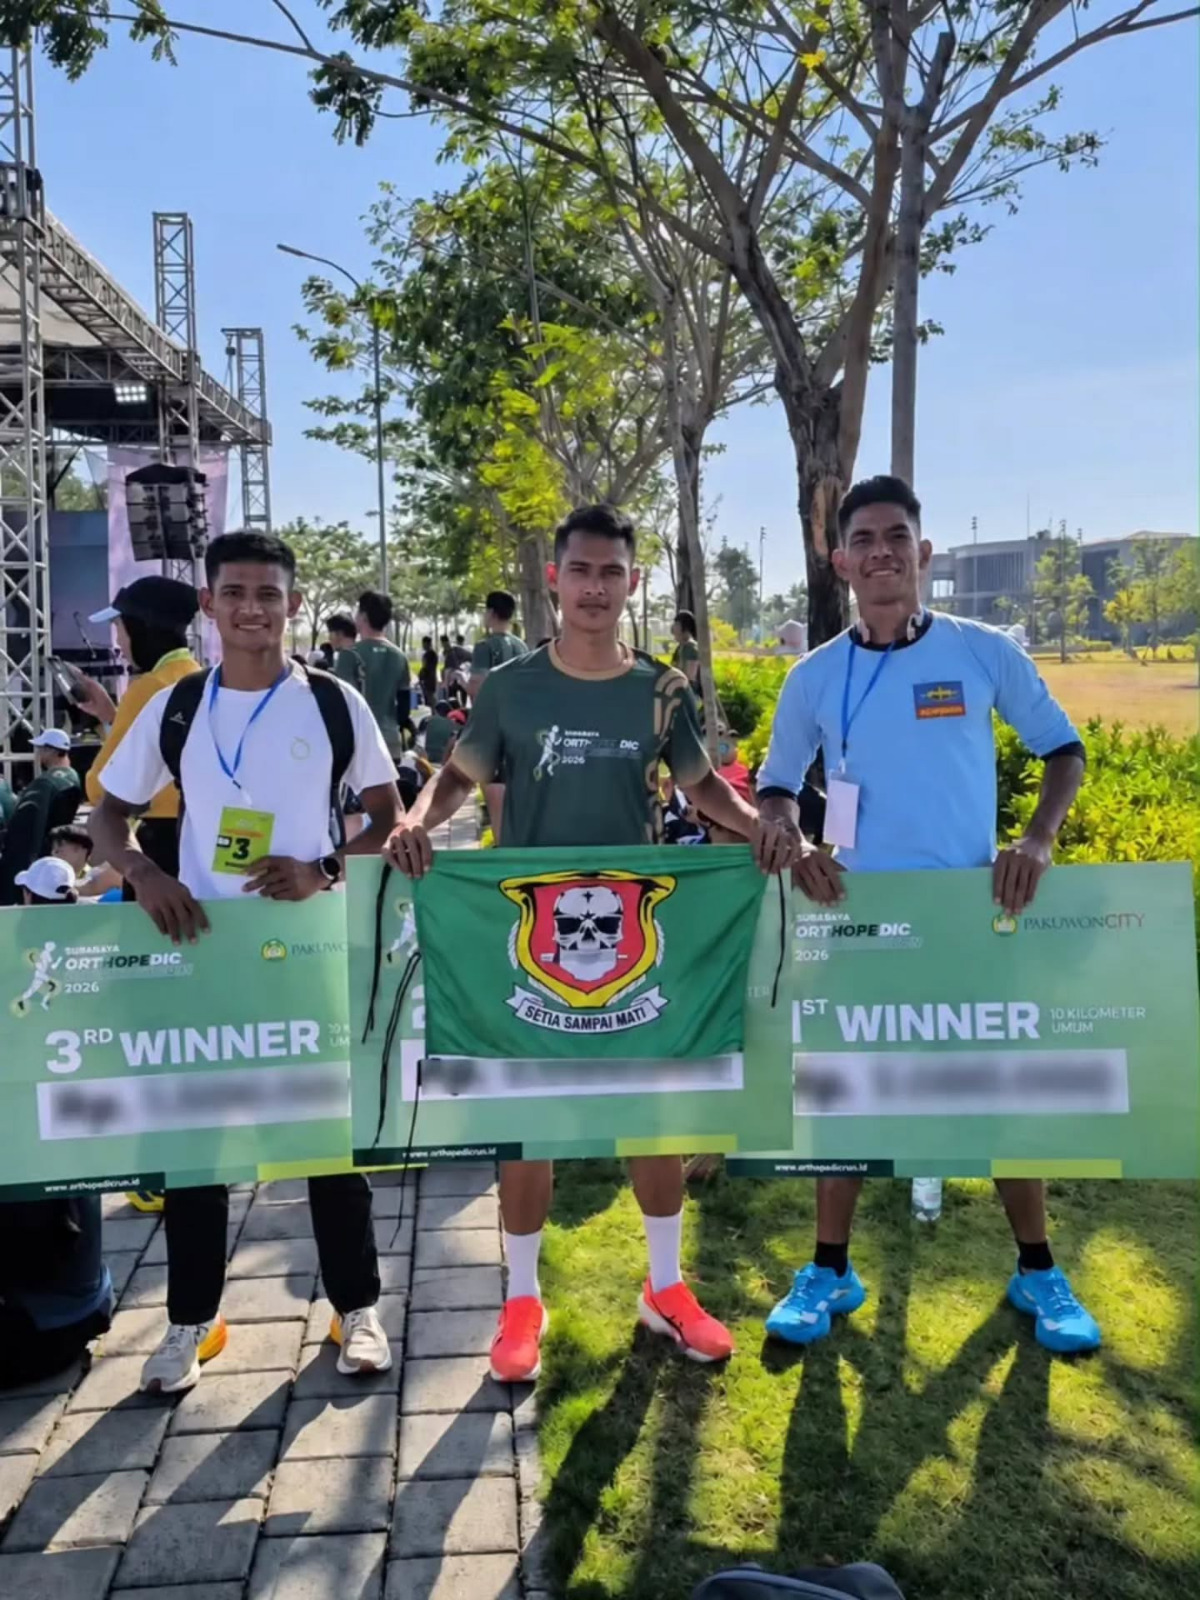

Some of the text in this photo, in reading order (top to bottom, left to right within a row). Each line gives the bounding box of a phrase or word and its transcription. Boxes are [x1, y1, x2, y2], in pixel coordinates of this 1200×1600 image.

[232, 837, 251, 860] 3
[796, 913, 851, 922] SURABAYA
[796, 923, 911, 938] ORTHOPEDIC
[64, 945, 120, 956] SURABAYA
[795, 950, 829, 961] 2026
[65, 952, 182, 970] ORTHOPEDIC
[65, 981, 99, 994] 2026
[525, 1005, 646, 1030] SETIA SAMPAI MATI
[1050, 1006, 1147, 1020] 10 KILOMETER
[836, 1002, 1040, 1042] WINNER
[1052, 1021, 1094, 1033] UMUM
[119, 1020, 320, 1067] WINNER
